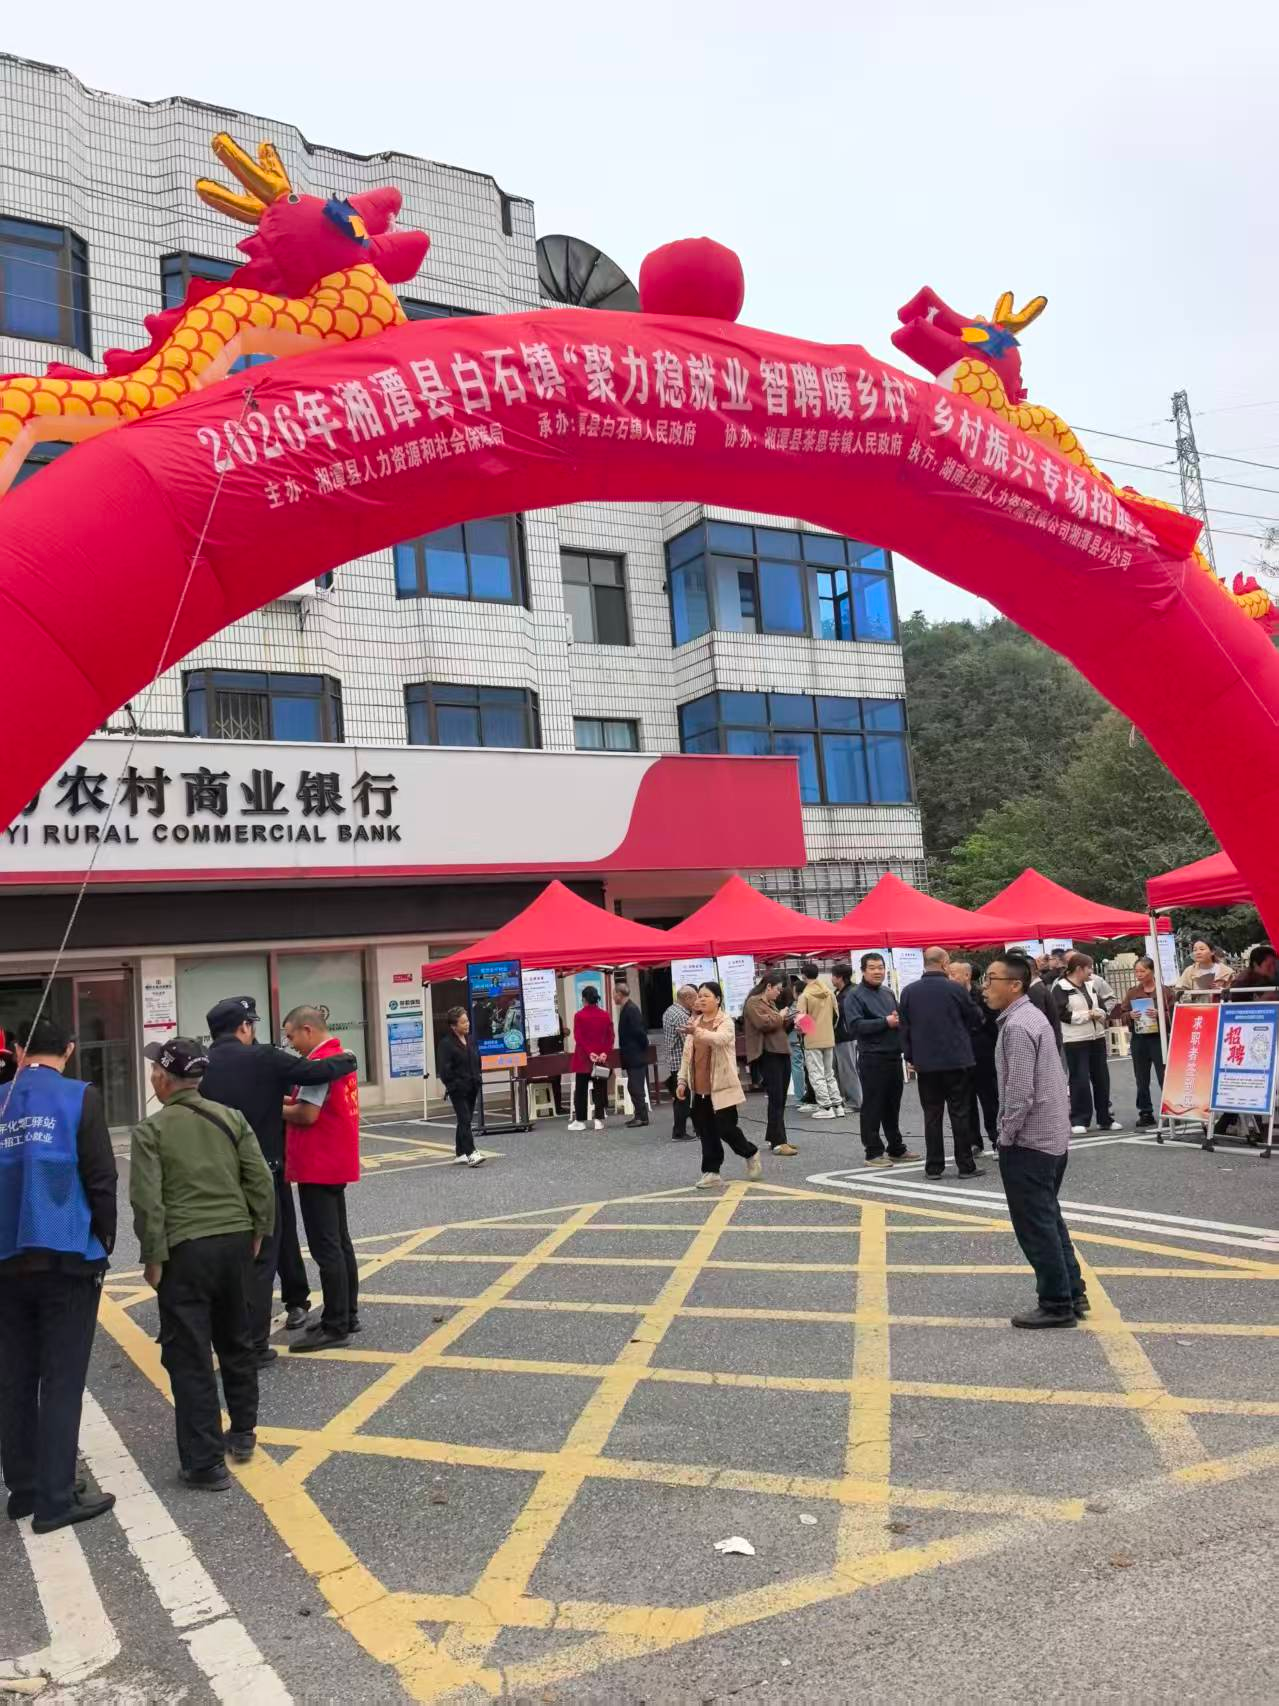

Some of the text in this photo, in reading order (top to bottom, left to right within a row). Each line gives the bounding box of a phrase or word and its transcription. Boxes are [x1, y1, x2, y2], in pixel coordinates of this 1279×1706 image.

[23, 765, 400, 818] 农村商业银行
[44, 823, 139, 844] RURAL
[152, 823, 327, 844] COMMERCIAL
[338, 824, 402, 843] BANK
[1224, 1026, 1245, 1066] 招聘
